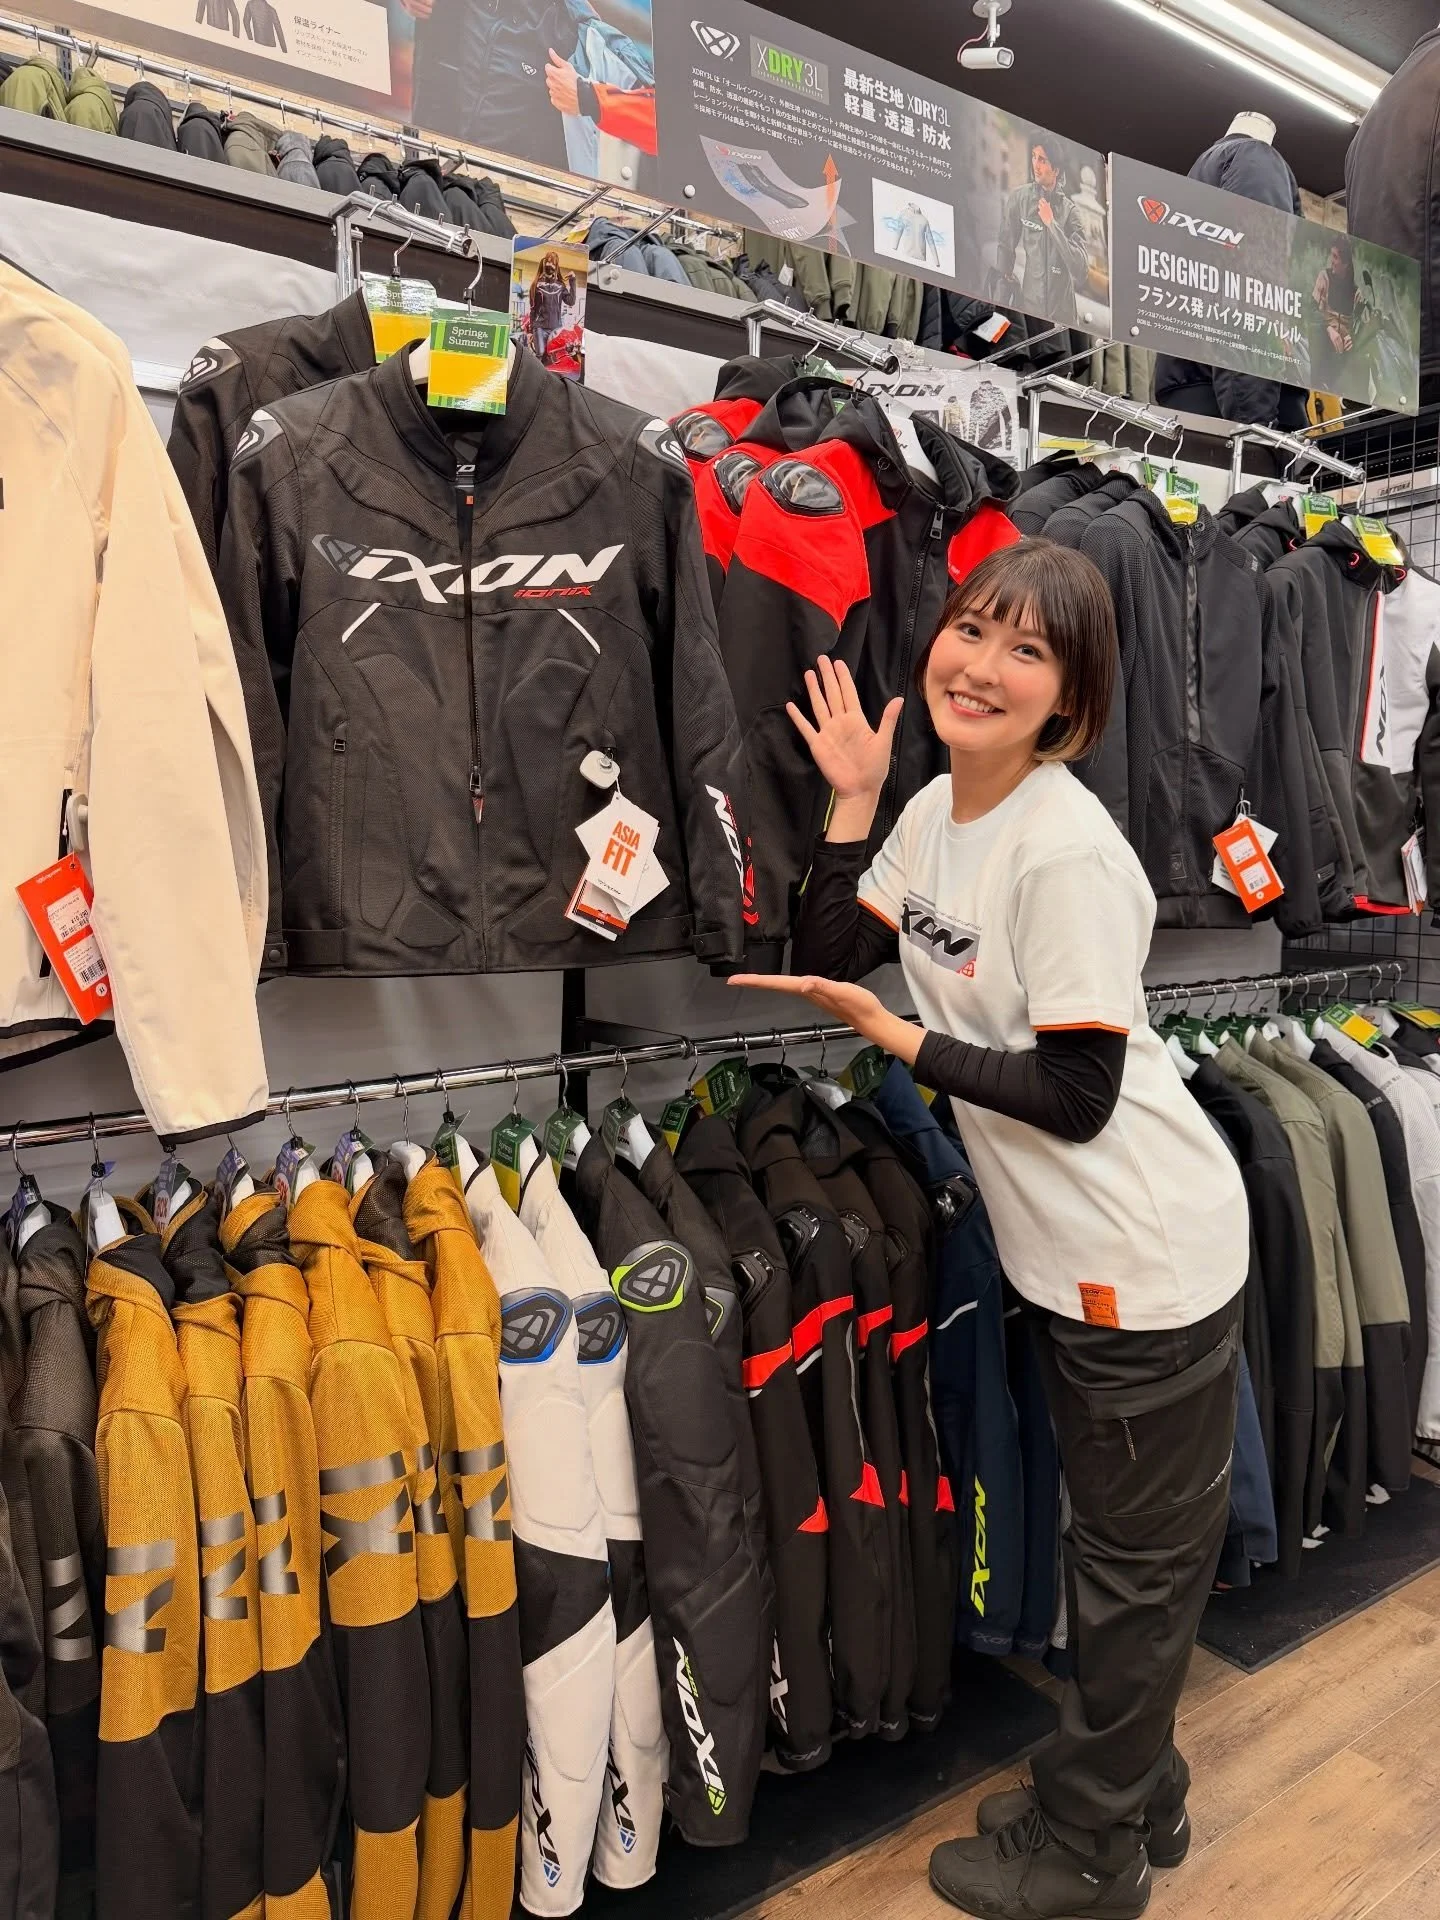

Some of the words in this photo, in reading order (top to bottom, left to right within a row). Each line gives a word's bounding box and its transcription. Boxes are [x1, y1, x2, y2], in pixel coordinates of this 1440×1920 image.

[293, 15, 341, 35] 保温ライナー
[757, 43, 823, 92] XDRY3L
[843, 67, 905, 110] 最新生地
[906, 93, 951, 128] XDRY3L
[1167, 211, 1245, 246] IXON
[1138, 245, 1219, 294] DESIGNED
[1225, 270, 1240, 300] IN
[1246, 277, 1303, 319] FRANCE
[451, 326, 489, 340] Spring&
[1138, 284, 1204, 319] フランス発
[1206, 303, 1301, 344] バイク用アパレル
[448, 336, 490, 349] Summer
[346, 544, 625, 604] IXON
[601, 837, 637, 877] FIT
[611, 820, 641, 851] ASIA
[673, 1636, 725, 1792] IXON
